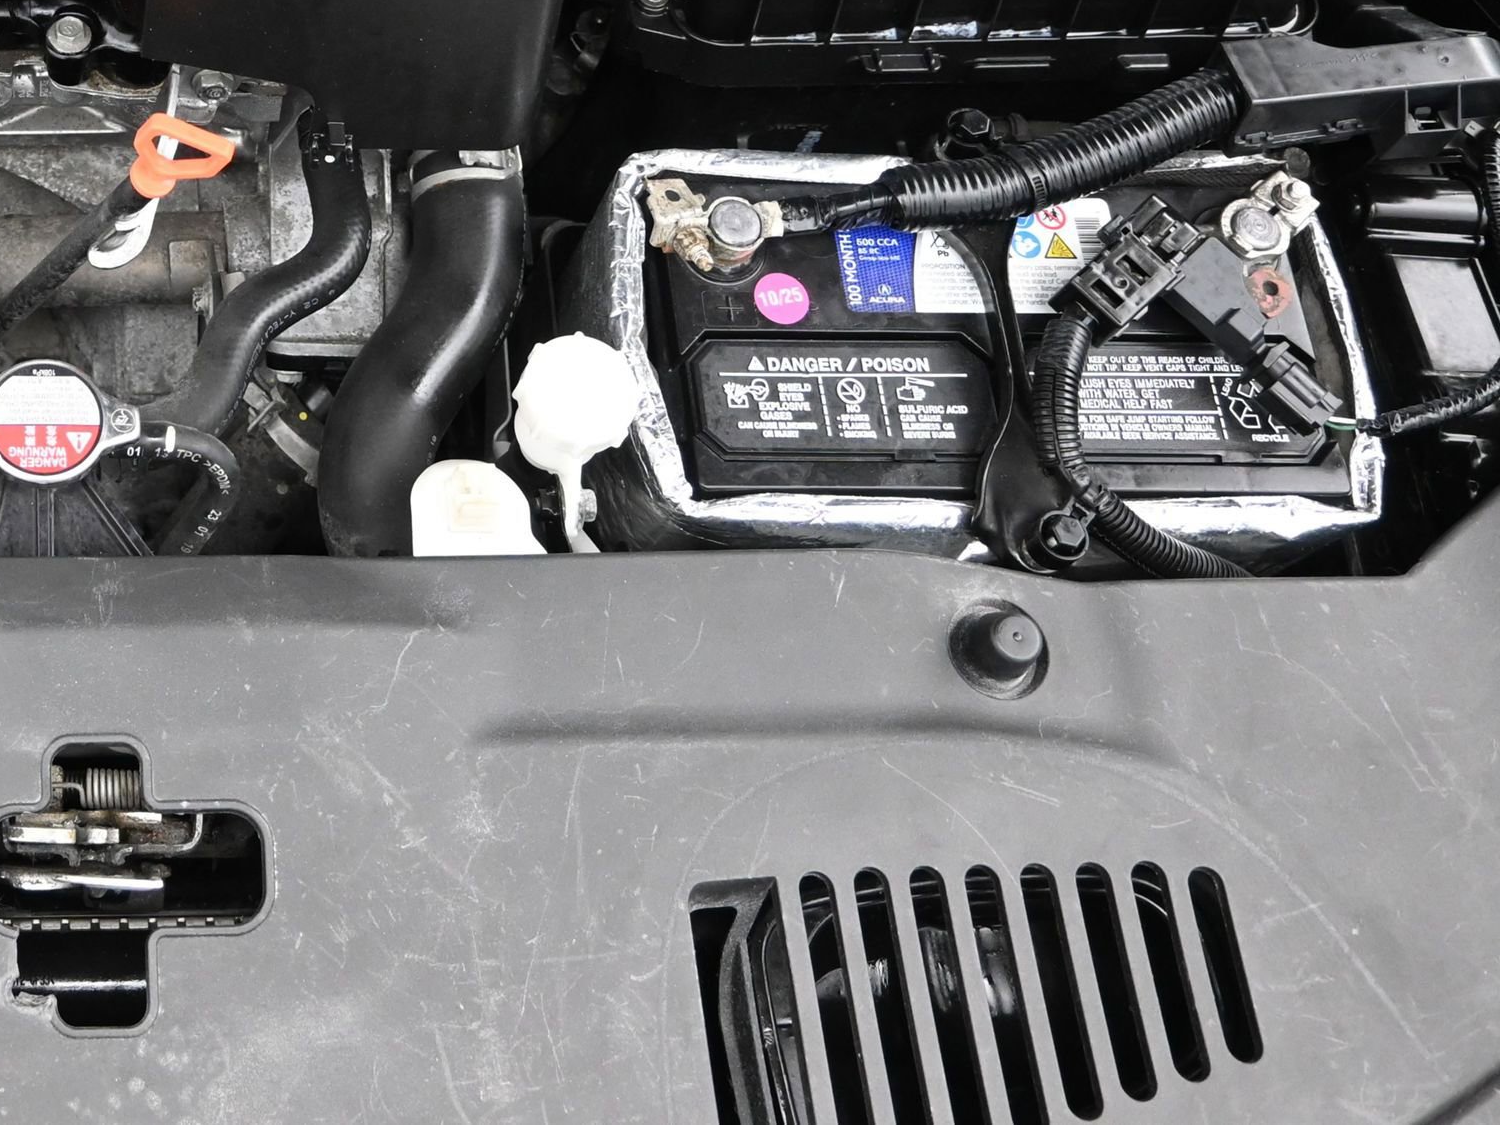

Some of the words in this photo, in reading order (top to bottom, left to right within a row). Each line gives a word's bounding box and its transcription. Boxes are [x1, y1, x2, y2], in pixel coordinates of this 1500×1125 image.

[876, 237, 899, 246] CCA
[758, 287, 803, 306] 10/25
[849, 284, 863, 306] 100
[869, 296, 906, 304] ACURA
[1088, 355, 1108, 363] KEEP
[1110, 355, 1126, 363] OUT
[1128, 355, 1139, 363] OF
[1140, 355, 1157, 364] THE
[1158, 355, 1184, 364] REACH
[1185, 356, 1196, 364] OF
[766, 357, 843, 372] DANGER
[846, 357, 858, 372] /
[860, 357, 931, 372] POISON
[1086, 363, 1104, 372] NOT
[1122, 364, 1143, 372] KEEP
[1143, 364, 1164, 372] VENT
[1165, 364, 1187, 372] CAPS
[1188, 364, 1211, 372] TIGHT
[1213, 364, 1230, 372] AND
[777, 383, 812, 392] SHIELD
[1080, 378, 1106, 388] LUSH
[1107, 378, 1132, 388] EYES
[1135, 379, 1196, 389] IMMEDIATELY
[1220, 377, 1234, 397] LEAD
[779, 392, 805, 401] EYES
[1141, 389, 1160, 398] GET
[758, 402, 811, 411] EXPLOSIVE
[846, 404, 861, 413] NO
[1080, 399, 1121, 409] MEDICAL
[1123, 399, 1147, 409] HELP
[1149, 399, 1173, 409] FAST
[898, 405, 945, 414] SULFURIC
[946, 405, 968, 414] ACID
[760, 411, 793, 420] GASES
[1089, 415, 1105, 423] FOR
[1105, 415, 1126, 423] SAFE
[1126, 415, 1146, 423] JUMP
[1185, 416, 1215, 424] FOLLOW
[1119, 423, 1150, 431] VEHICLE
[1251, 433, 1291, 442] RECYCLE
[9, 446, 67, 457] WARNUNG
[19, 457, 68, 468] DANGER
[126, 446, 141, 457] 01
[176, 448, 202, 463] TPC
[203, 459, 231, 495] >EPDM<
[207, 509, 222, 522] 23
[194, 525, 209, 537] 01
